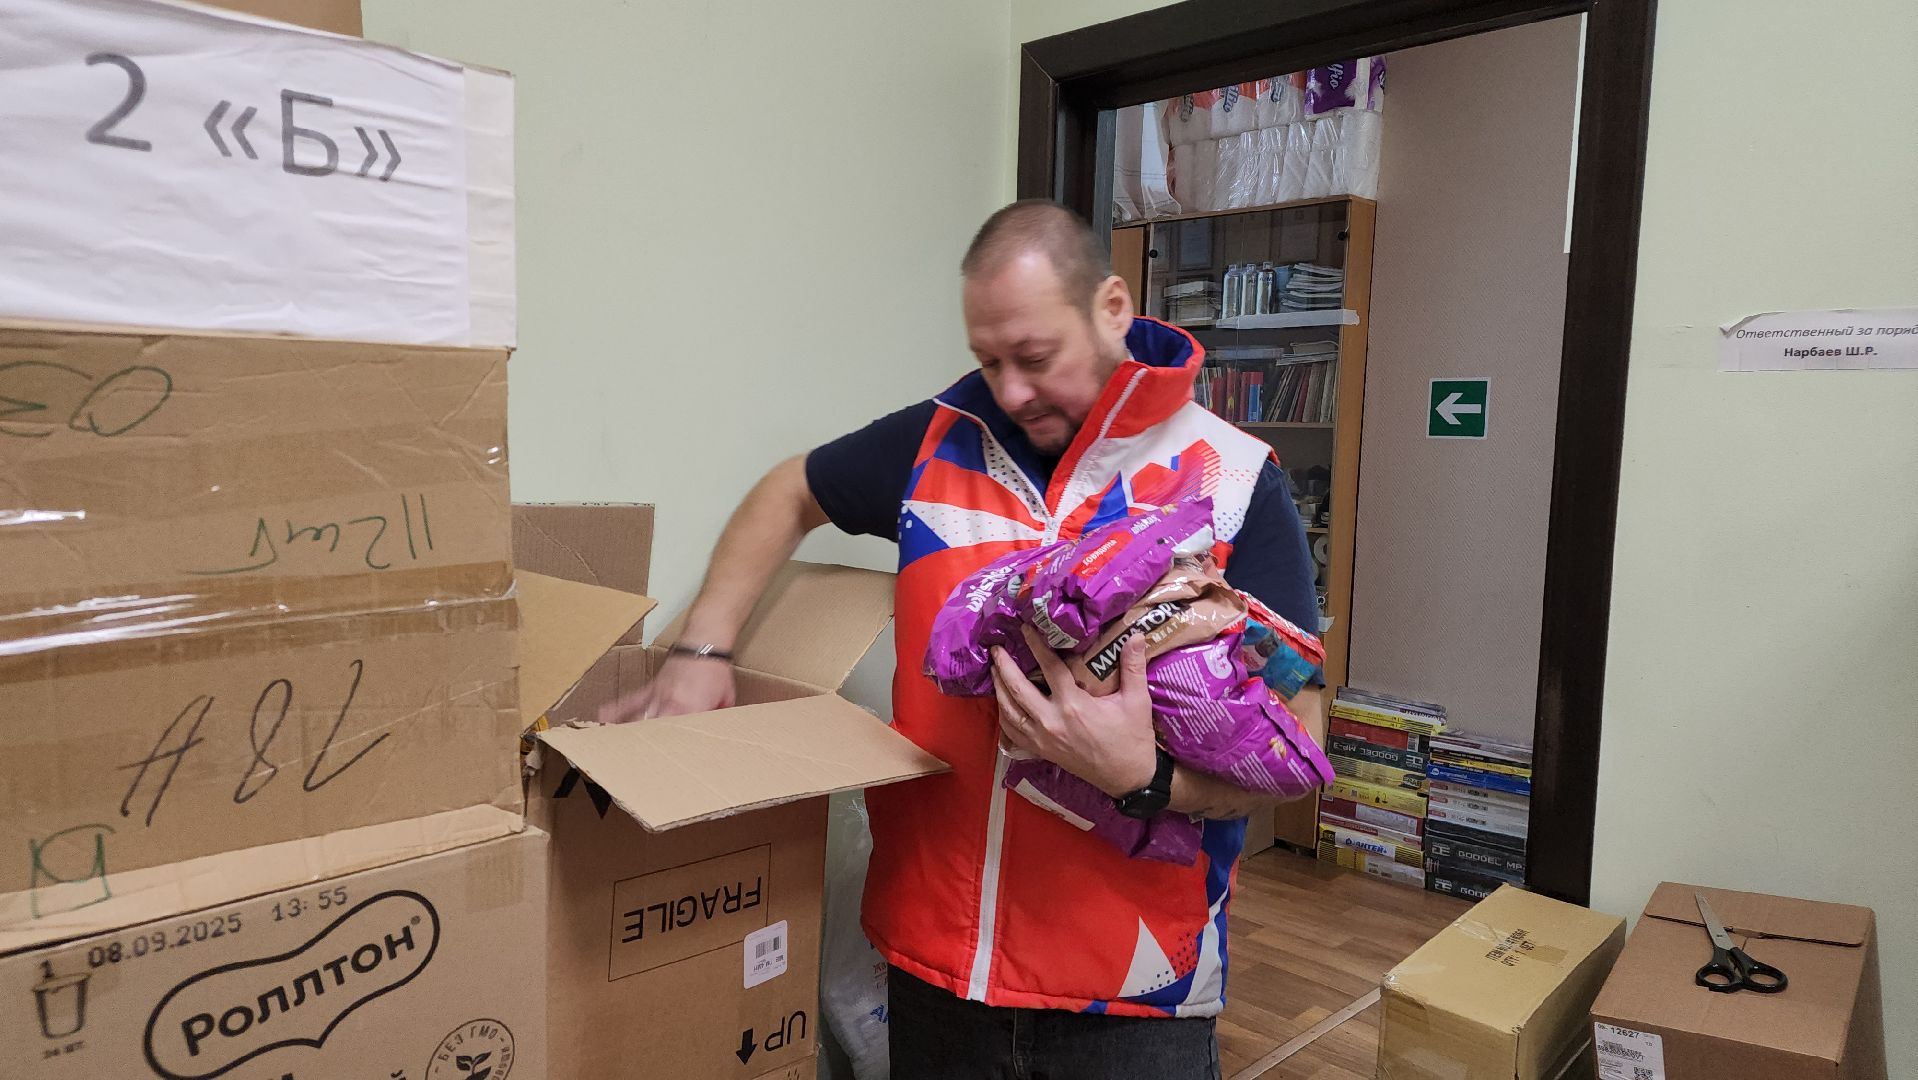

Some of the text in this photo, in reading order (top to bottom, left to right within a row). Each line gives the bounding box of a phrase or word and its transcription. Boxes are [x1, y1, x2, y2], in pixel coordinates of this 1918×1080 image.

[85, 52, 153, 153] 2
[1736, 325, 1854, 339] Ответственный
[1856, 326, 1873, 336] за
[1784, 346, 1878, 359] Нарбаев Ш.Р.
[621, 876, 763, 944] FRAGILE
[87, 913, 244, 969] 08.09.2025
[437, 1032, 464, 1061] БЕЗ
[763, 1010, 807, 1052] UP
